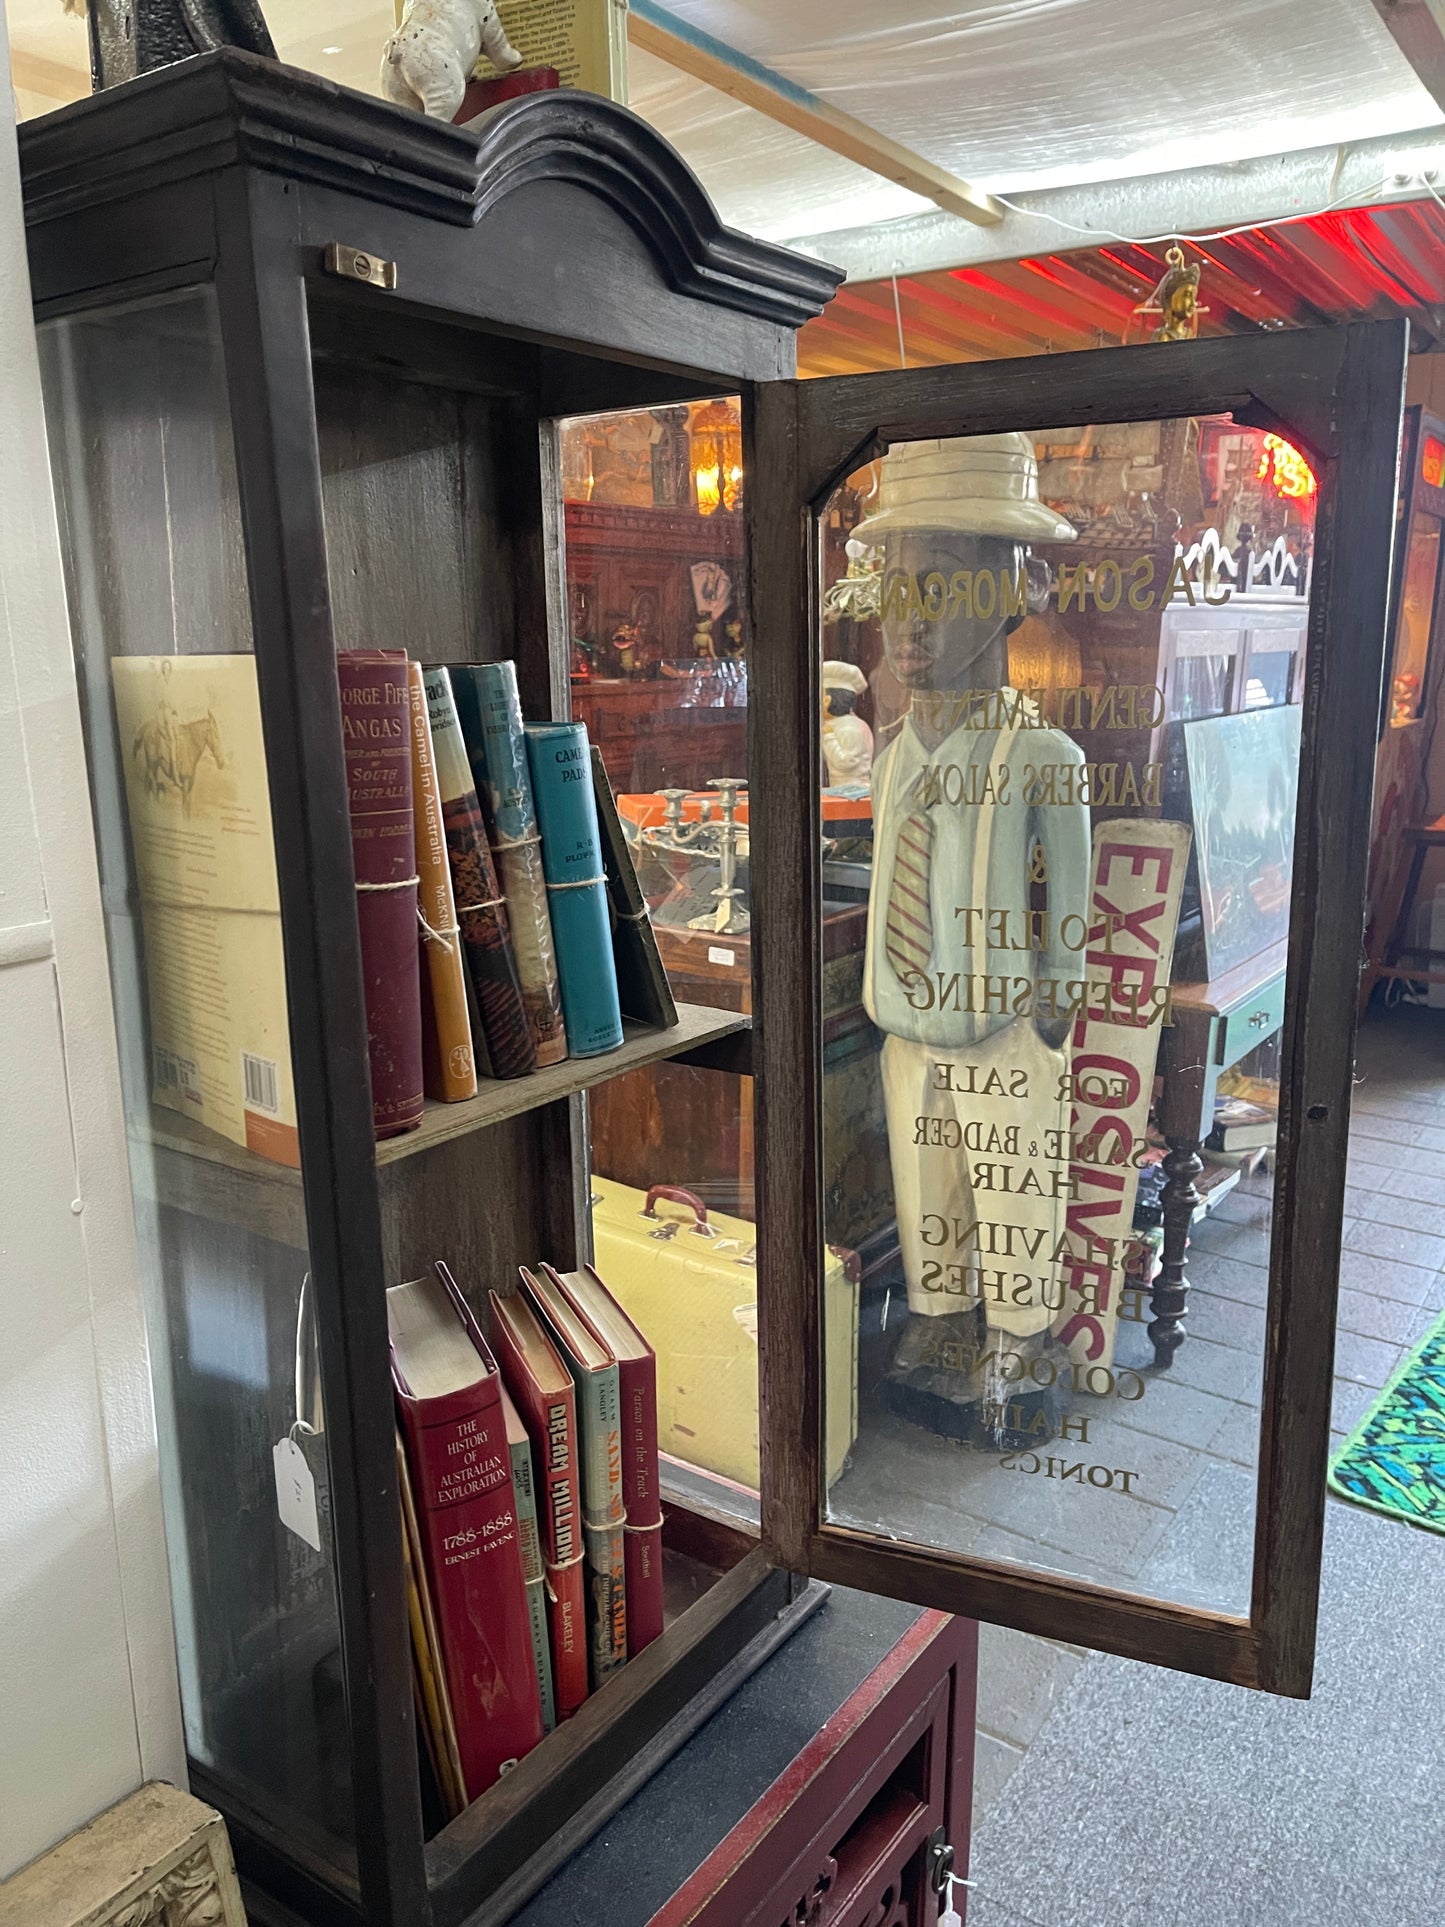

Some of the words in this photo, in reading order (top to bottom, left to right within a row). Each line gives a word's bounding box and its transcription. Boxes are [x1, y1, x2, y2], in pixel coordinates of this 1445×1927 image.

[342, 687, 380, 705] ORGE
[410, 685, 421, 711] the
[343, 714, 402, 738] ANGAS
[414, 717, 431, 767] Camel
[352, 768, 398, 782] SOUTH
[420, 772, 433, 787] in
[349, 785, 409, 801] USTRALIA
[424, 793, 442, 865] Australia
[598, 1383, 607, 1422] LANGLEY
[634, 1387, 645, 1424] Parson
[456, 1419, 477, 1437] THE
[548, 1403, 569, 1473] DREAM
[635, 1429, 643, 1441] on
[447, 1430, 489, 1455] HISTORY
[636, 1446, 648, 1462] the
[463, 1450, 478, 1465] OF
[440, 1454, 502, 1487] AUSTRALIAN
[637, 1467, 649, 1498] Track
[438, 1467, 507, 1503] EXPLORATION
[483, 1531, 516, 1553] FAVENC
[444, 1547, 482, 1565] ERNEST
[642, 1545, 650, 1578] Southall
[562, 1602, 574, 1653] BLAKELEY
